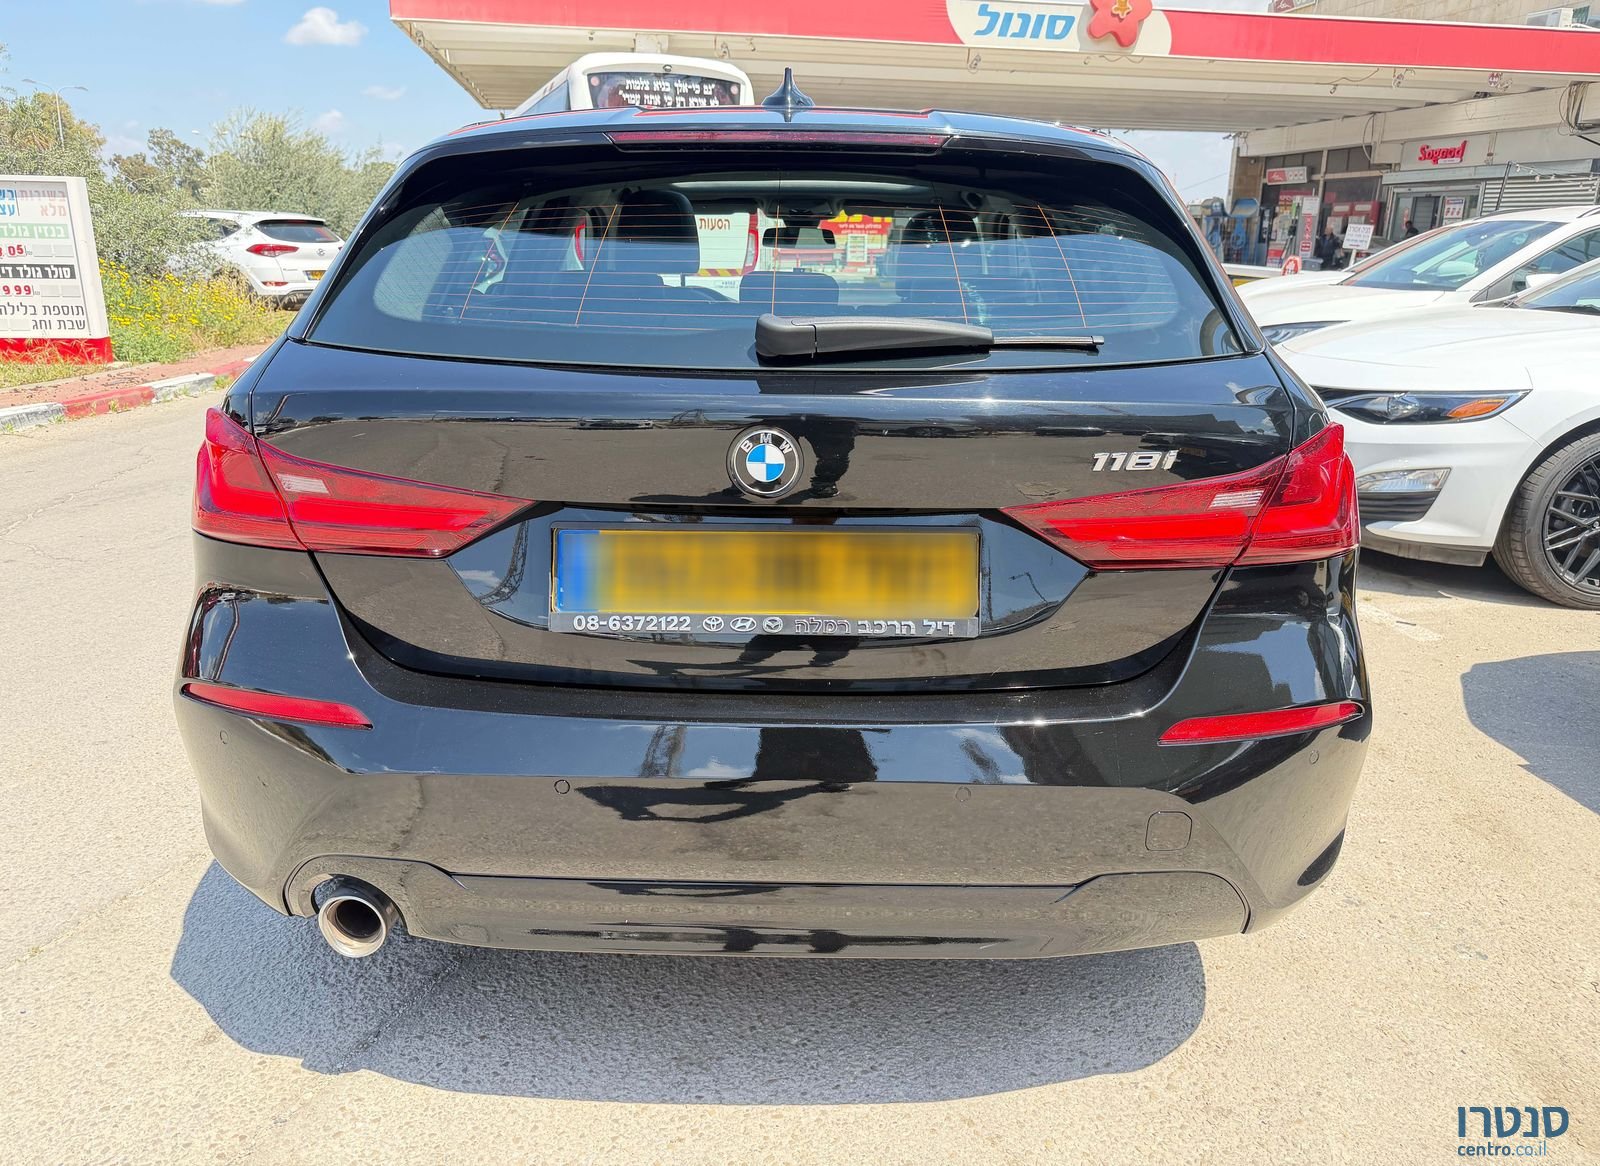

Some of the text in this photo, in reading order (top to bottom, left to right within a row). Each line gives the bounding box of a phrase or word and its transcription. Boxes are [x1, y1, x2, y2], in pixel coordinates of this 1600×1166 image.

[974, 4, 1075, 39] סונול
[625, 77, 650, 90] צלמות
[19, 190, 66, 201] בשירות
[40, 203, 67, 216] מלא
[0, 223, 66, 239] בנזין גולד
[699, 217, 730, 231] הסעות
[16, 264, 43, 278] גולד
[44, 265, 71, 279] סולר
[42, 304, 84, 316] תוספת
[31, 319, 86, 330] שבת וחג
[740, 432, 793, 454] BMW
[1091, 449, 1179, 472] 118i
[573, 615, 692, 632] 08-6372122
[795, 617, 957, 635] דיל הרכב רמלה
